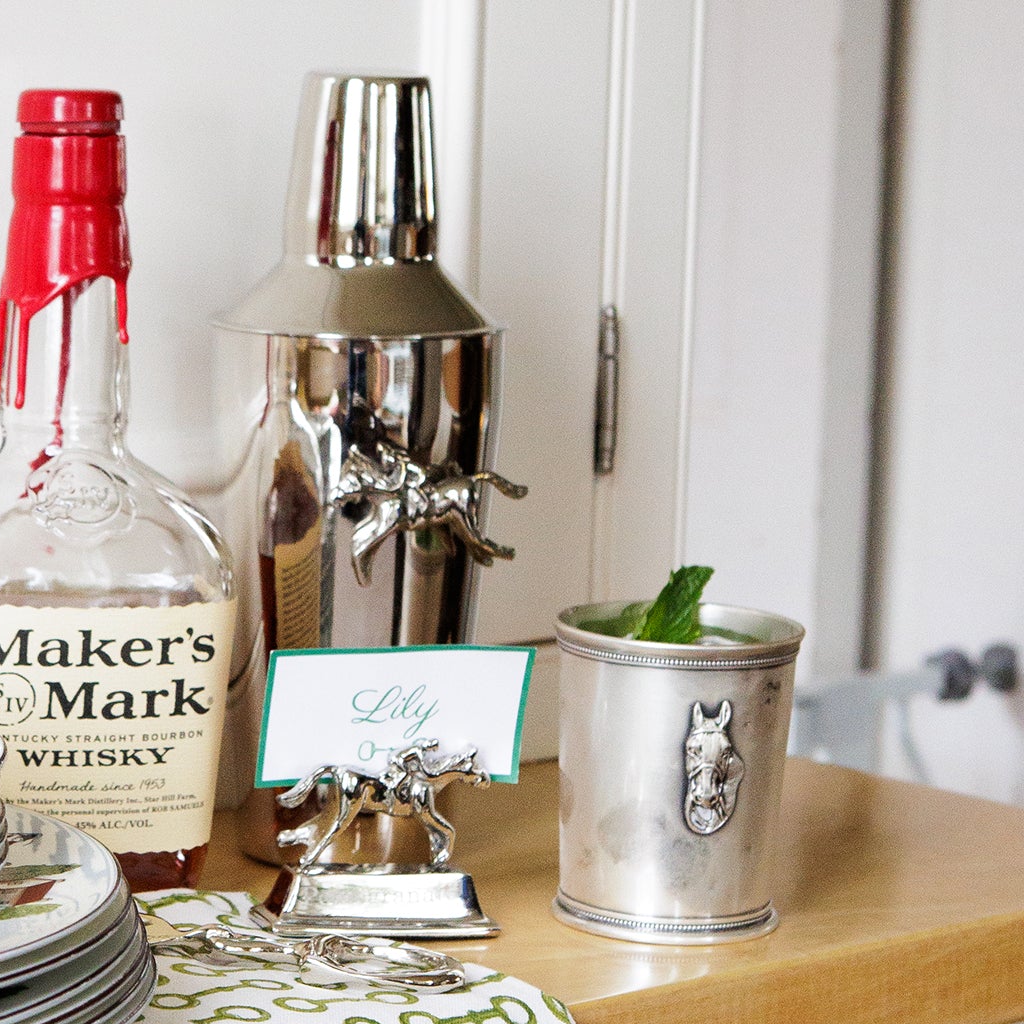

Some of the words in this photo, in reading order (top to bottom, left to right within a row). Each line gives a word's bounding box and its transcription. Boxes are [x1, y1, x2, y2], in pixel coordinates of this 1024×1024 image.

[6, 697, 29, 713] IV
[39, 679, 211, 720] Mark
[351, 684, 439, 739] Lily
[66, 733, 136, 743] STRAIGHT
[142, 730, 204, 742] BOURBON
[17, 747, 174, 767] WHISKY
[19, 780, 95, 792] Handmade
[101, 781, 136, 792] since
[139, 778, 166, 791] 1953
[16, 797, 29, 805] the
[61, 808, 95, 817] personal
[96, 808, 140, 817] supervision
